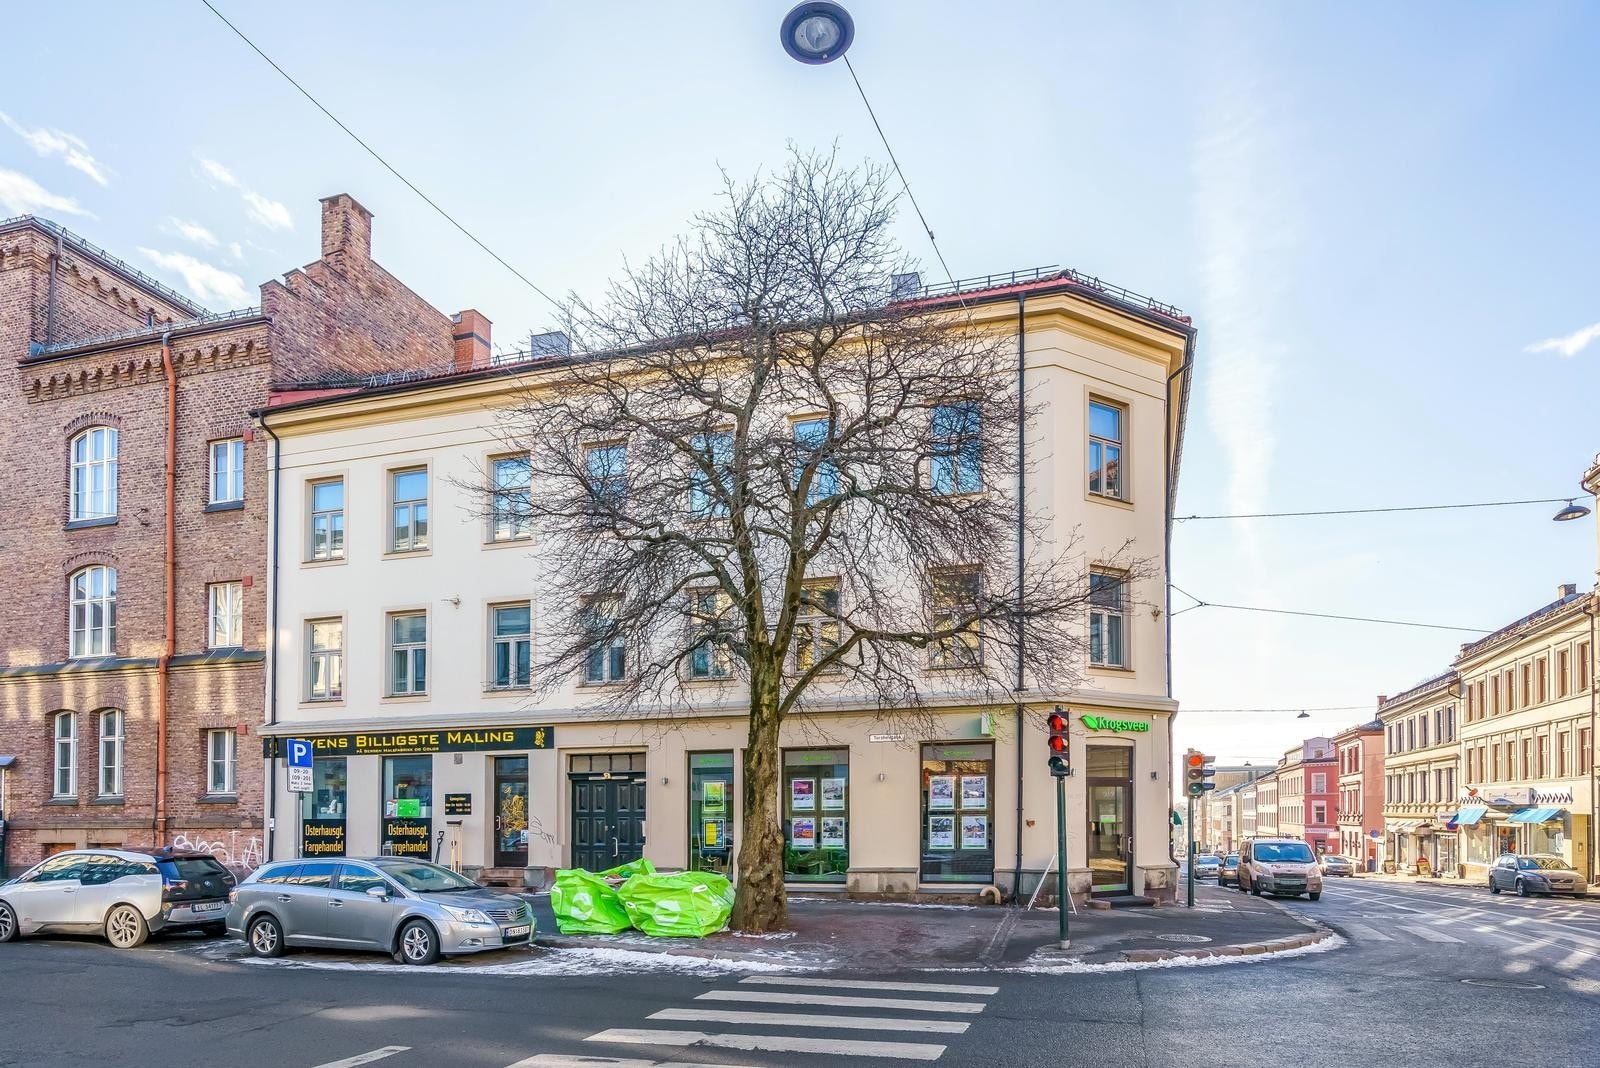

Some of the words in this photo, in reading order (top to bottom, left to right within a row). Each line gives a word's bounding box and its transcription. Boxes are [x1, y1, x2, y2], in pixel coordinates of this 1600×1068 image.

[1099, 717, 1151, 732] Krogsveen
[356, 734, 439, 747] BILLIGSTE
[447, 731, 514, 744] MALING
[294, 743, 307, 764] P
[305, 824, 344, 839] Osterhausgt.
[388, 823, 429, 839] Osterhausgt.
[305, 840, 344, 855] Fargehandel
